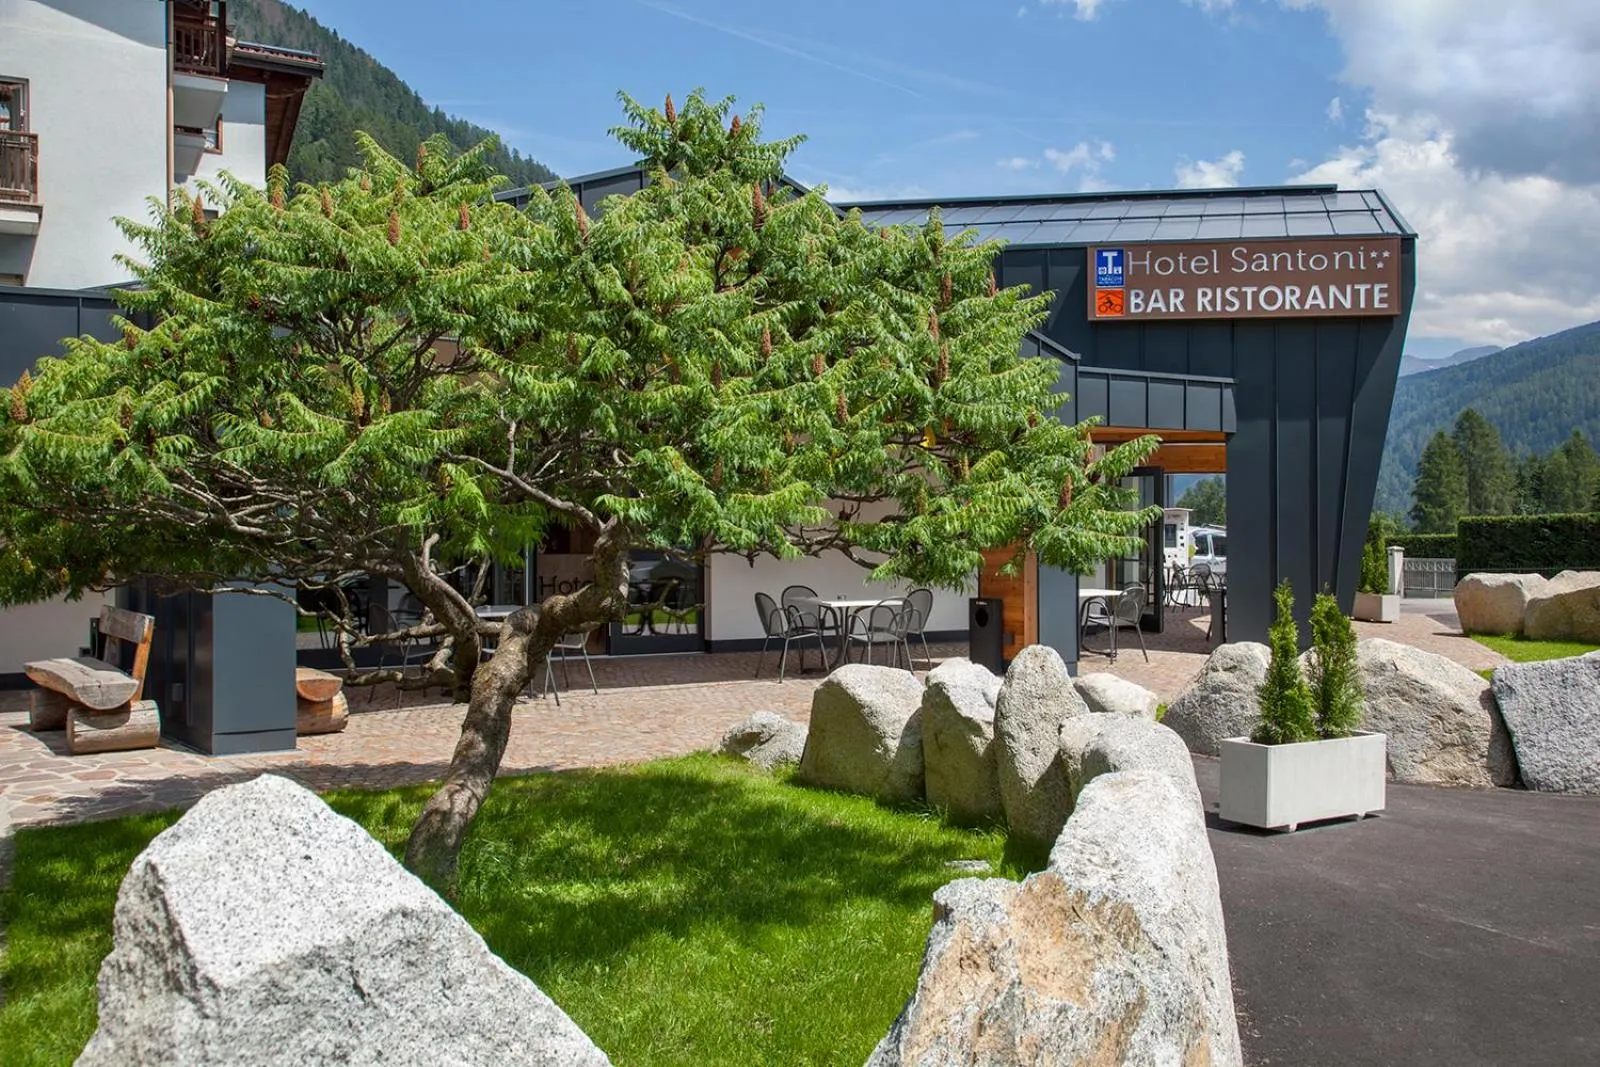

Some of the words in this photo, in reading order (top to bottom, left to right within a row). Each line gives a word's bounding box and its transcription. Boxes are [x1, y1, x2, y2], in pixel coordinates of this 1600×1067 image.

[1128, 249, 1219, 276] Hotel
[1231, 246, 1366, 273] Santoni
[1130, 288, 1185, 313] BAR
[1197, 283, 1389, 312] RISTORANTE
